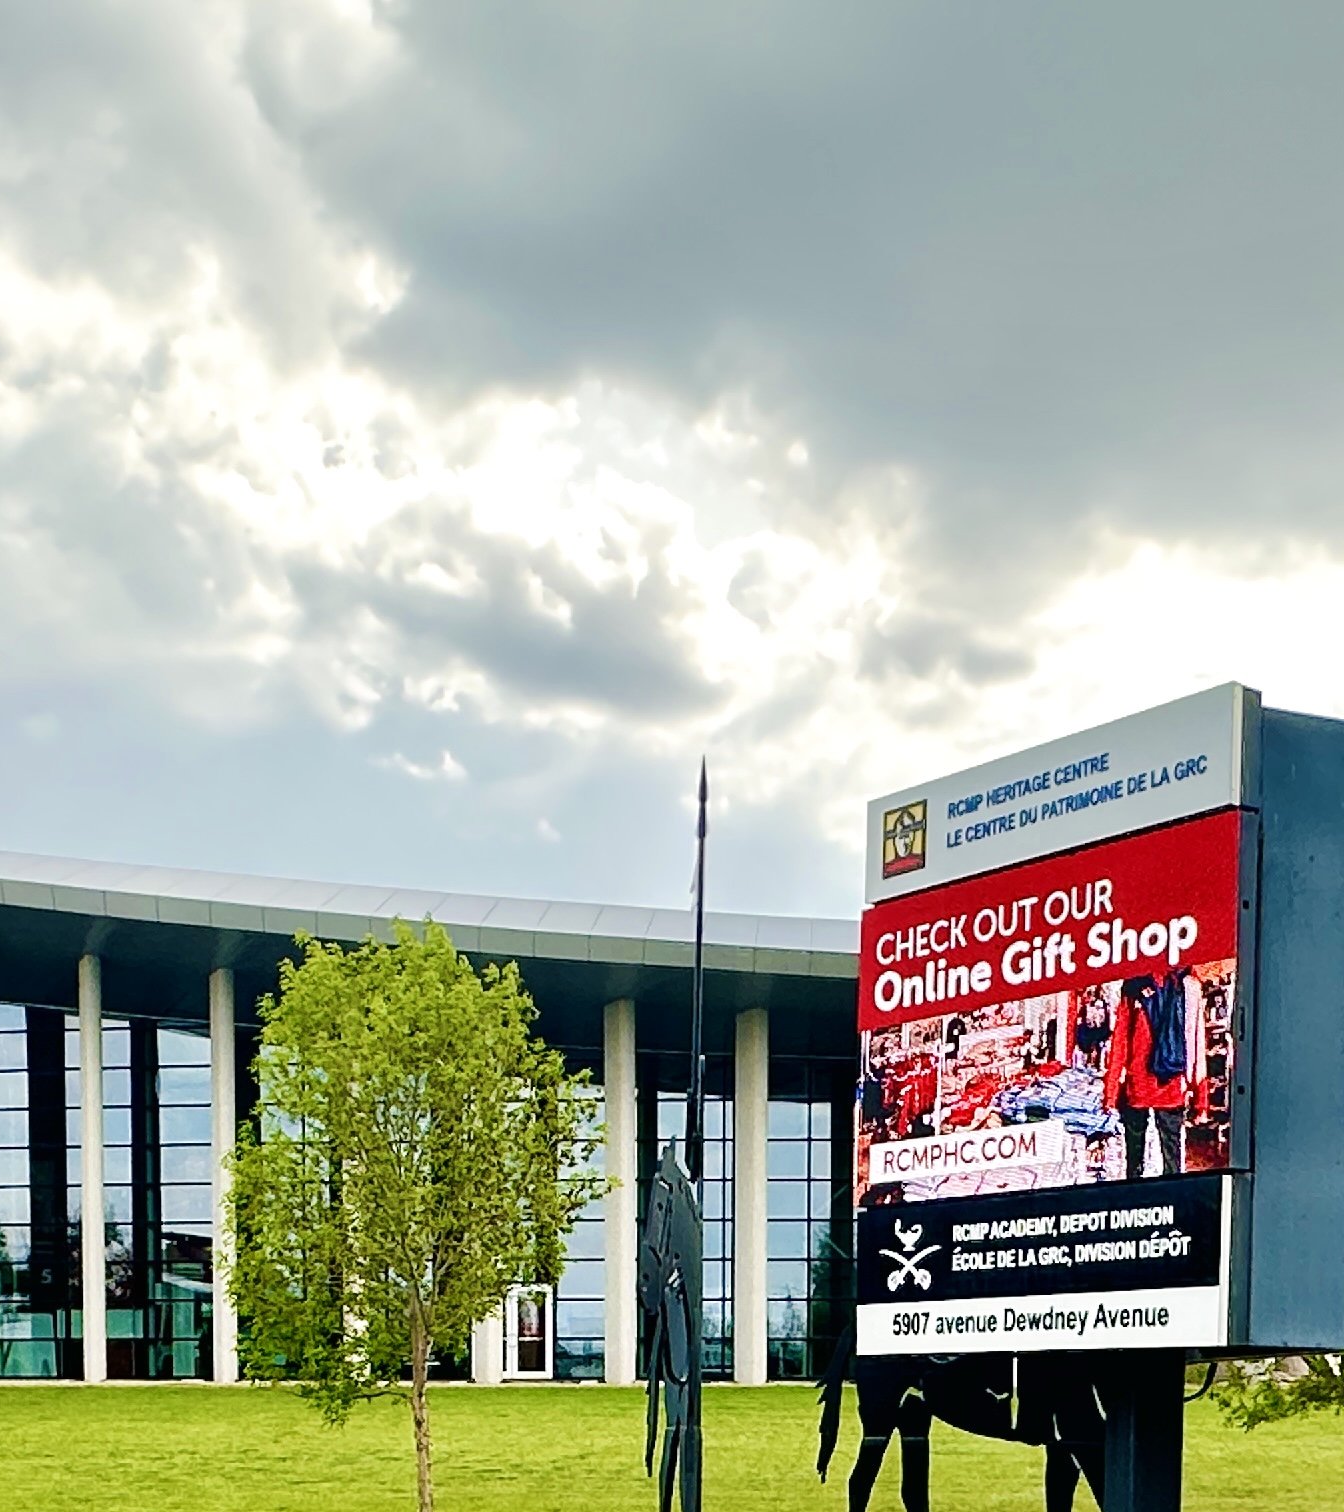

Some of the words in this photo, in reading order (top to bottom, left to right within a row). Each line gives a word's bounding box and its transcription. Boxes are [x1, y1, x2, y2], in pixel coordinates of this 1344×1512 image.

[947, 794, 983, 819] RCMP
[986, 771, 1050, 808] HERITAGE
[1054, 753, 1110, 786] CENTRE
[947, 829, 963, 848] LE
[965, 813, 1016, 842] CENTRE
[1019, 805, 1038, 827] DU
[1041, 781, 1124, 821] PATRIMOINE
[1127, 773, 1147, 795] DE
[1150, 767, 1170, 788] LA
[1174, 755, 1207, 781] GRC
[876, 914, 968, 965] CHECK
[973, 896, 1039, 942] OUT
[1044, 879, 1113, 926] OUR
[874, 958, 992, 1012] Online
[1002, 932, 1076, 985] Gift
[1086, 915, 1197, 968] Shop
[884, 1131, 1037, 1174] RCMPHC.COM
[952, 1222, 990, 1242] RCMP
[989, 1215, 1057, 1240] ACADEMY,
[1060, 1211, 1108, 1233] DEPOT
[1110, 1205, 1174, 1229] DIVISION
[952, 1246, 995, 1271] ÉCOLE
[997, 1249, 1016, 1268] DE
[1018, 1248, 1037, 1267] LA
[1038, 1245, 1072, 1267] GRC,
[1075, 1240, 1136, 1263] DIVISION
[1139, 1229, 1191, 1258] DÉPÔT
[893, 1312, 930, 1336] 5907
[936, 1313, 997, 1334] avenue
[1004, 1306, 1089, 1336] Dewdney
[1093, 1303, 1170, 1329] Avenue
